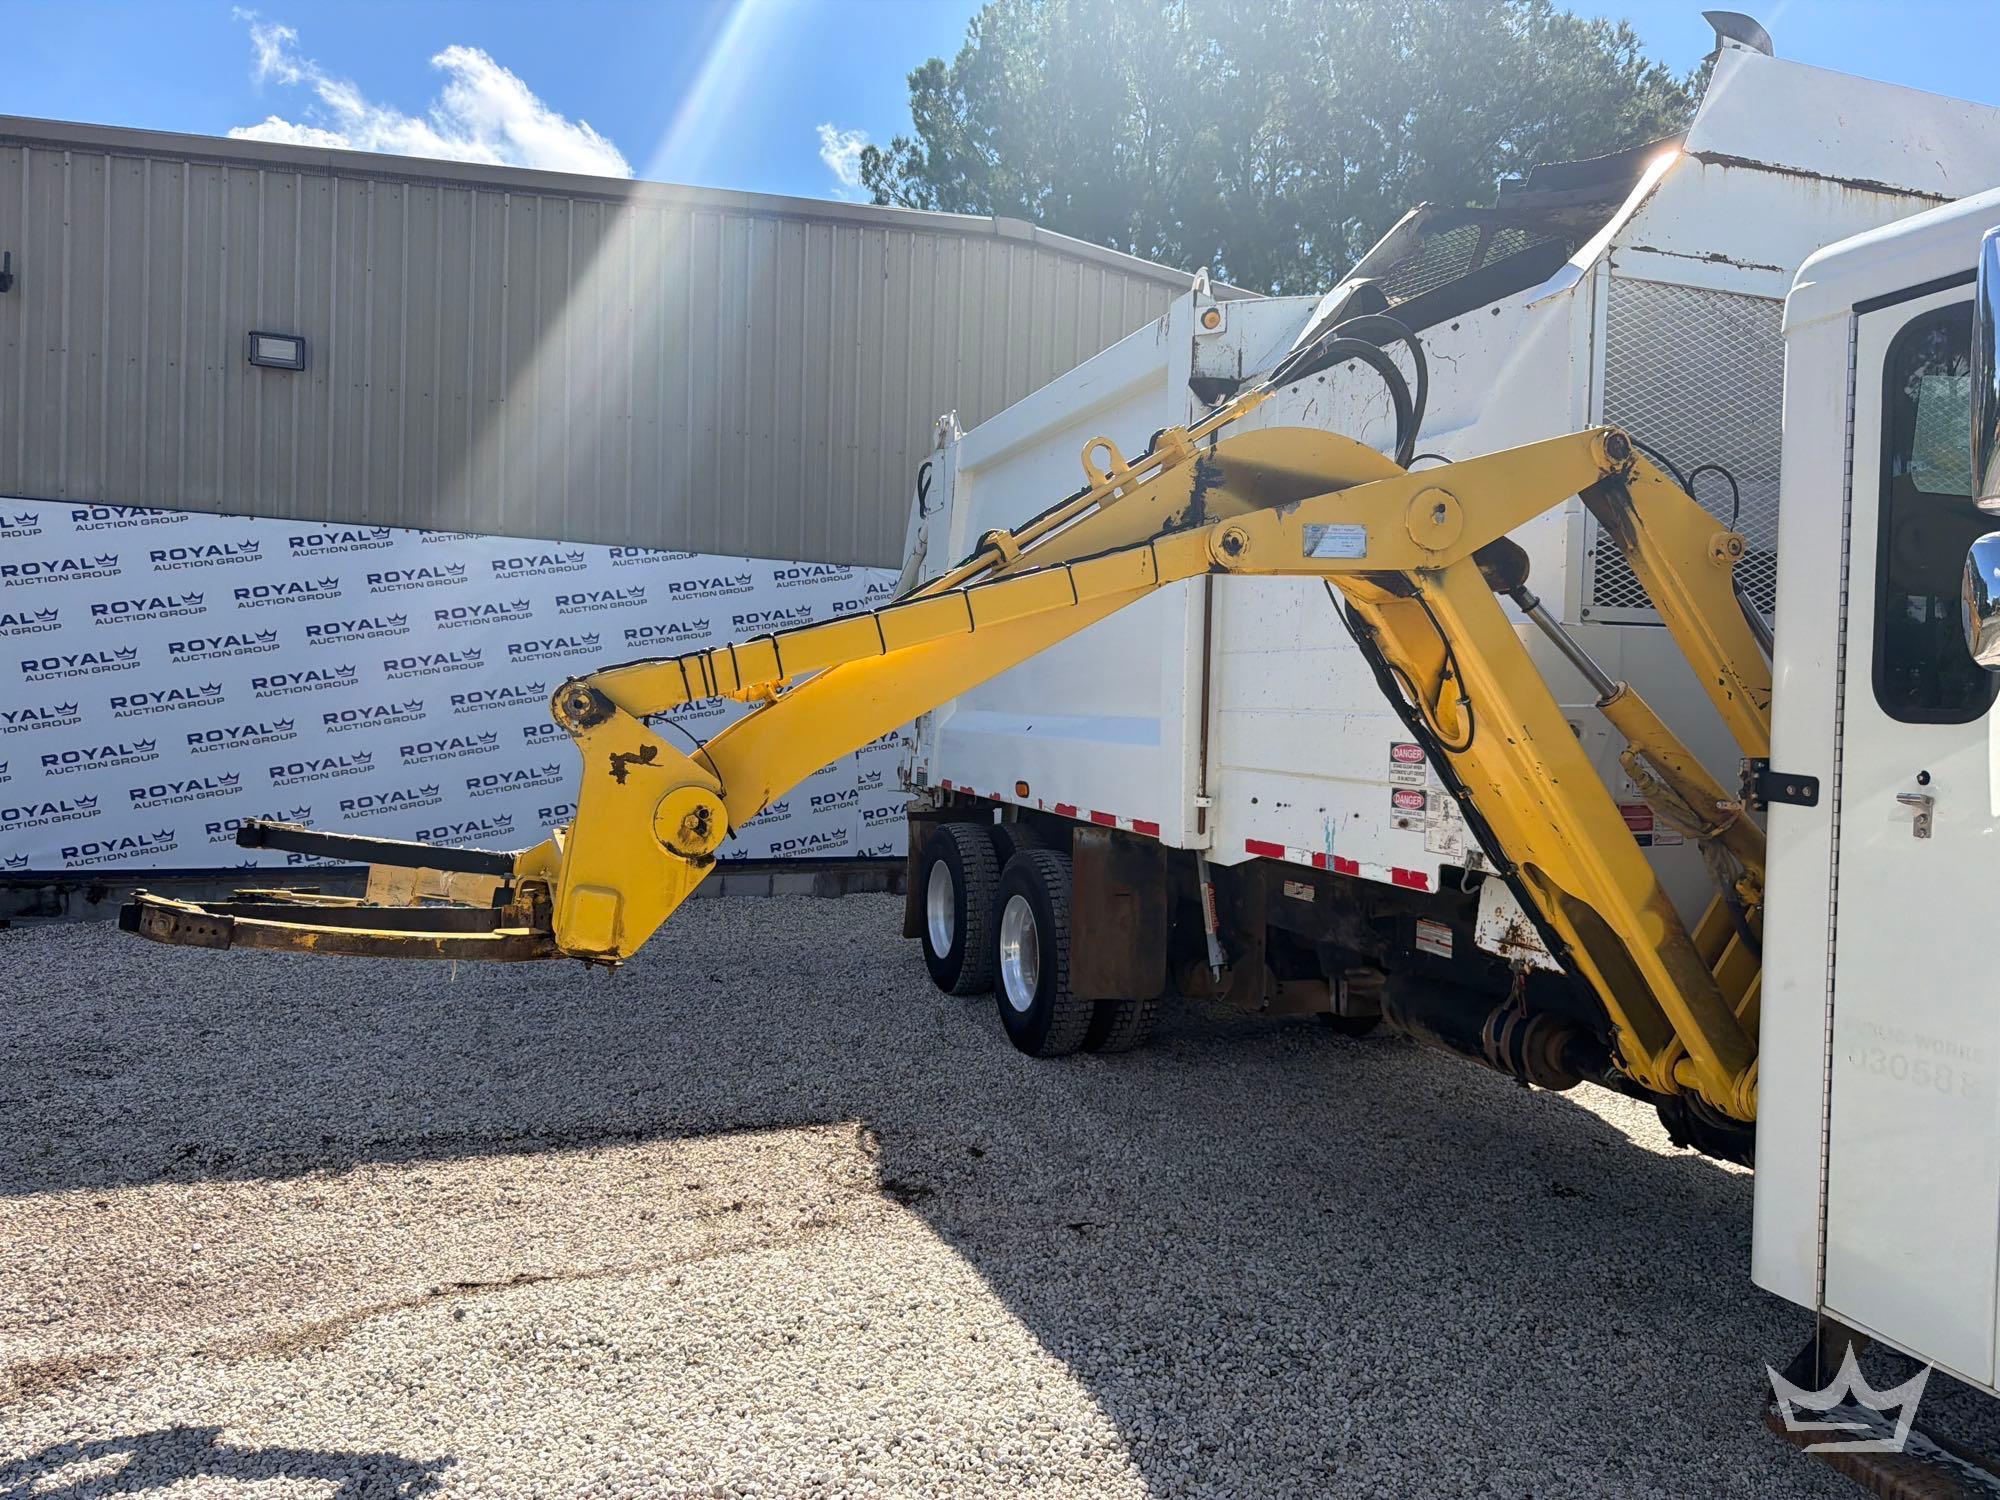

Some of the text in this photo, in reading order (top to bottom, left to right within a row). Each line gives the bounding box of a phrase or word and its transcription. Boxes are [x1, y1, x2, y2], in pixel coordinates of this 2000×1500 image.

[75, 515, 189, 531] AUCTION GROUP
[1, 528, 42, 538] ROUP
[288, 530, 371, 549] ROYAL
[149, 544, 238, 563] ROYAL
[292, 540, 394, 558] AUCTION GROUP
[0, 557, 96, 578] ROYAL
[153, 554, 263, 572] AUCTION GROUP
[491, 554, 566, 571] ROYAL
[612, 552, 698, 567] AUCTION GROUP
[4, 568, 122, 588] AUCTION GROUP
[366, 566, 446, 585] ROYAL
[495, 564, 588, 579] AUCTION GROUP
[773, 565, 836, 581] ROYAL
[776, 574, 853, 588] AUCTION GROUP
[234, 580, 319, 600] ROYAL
[370, 576, 468, 594] AUCTION GROUP
[668, 576, 736, 594] ROYAL
[672, 586, 754, 602] AUCTION GROUP
[90, 596, 182, 617] ROYAL
[237, 590, 342, 609] AUCTION GROUP
[555, 589, 628, 607] ROYAL
[558, 598, 648, 615] AUCTION GROUP
[94, 606, 207, 626] AUCTION GROUP
[434, 602, 512, 621] ROYAL
[438, 612, 533, 630] AUCTION GROUP
[732, 608, 796, 626] ROYAL
[11, 623, 62, 635] GROUP
[306, 617, 388, 637] ROYAL
[624, 622, 694, 640] ROYAL
[734, 617, 814, 634] AUCTION GROUP
[168, 634, 256, 655] ROYAL
[309, 627, 410, 646] AUCTION GROUP
[507, 636, 582, 656] ROYAL
[626, 630, 712, 648] AUCTION GROUP
[20, 651, 115, 674] ROYAL
[172, 644, 280, 664] AUCTION GROUP
[383, 652, 462, 672] ROYAL
[511, 645, 602, 663] AUCTION GROUP
[24, 661, 141, 682] AUCTION GROUP
[251, 669, 336, 690] ROYAL
[387, 661, 484, 680] AUCTION GROUP
[255, 678, 359, 699] AUCTION GROUP
[450, 686, 527, 706] ROYAL
[110, 687, 200, 710] ROYAL
[114, 696, 225, 718] AUCTION GROUP
[453, 694, 548, 714] AUCTION GROUP
[1, 707, 55, 723] YAL
[31, 717, 82, 730] GROUP
[322, 704, 404, 725] ROYAL
[326, 712, 426, 734] AUCTION GROUP
[690, 708, 726, 720] GROUP
[186, 723, 274, 746] ROYAL
[190, 732, 298, 754] AUCTION GROUP
[40, 744, 134, 768] ROYAL
[400, 736, 478, 758] ROYAL
[403, 744, 500, 766] AUCTION GROUP
[1394, 748, 1422, 759] DANGER
[45, 753, 160, 776] AUCTION GROUP
[269, 756, 352, 779] ROYAL
[272, 764, 375, 788] AUCTION GROUP
[466, 768, 542, 790] ROYAL
[129, 778, 219, 802] ROYAL
[469, 776, 564, 798] AUCTION GROUP
[133, 786, 243, 810] AUCTION GROUP
[339, 789, 420, 812] ROYAL
[810, 789, 859, 806] ROYA
[1394, 794, 1422, 805] DANGER
[1, 800, 74, 821] OYAL
[51, 809, 102, 823] GROUP
[343, 797, 442, 820] AUCTION GROUP
[812, 801, 854, 814] AUCTION
[757, 813, 792, 825] GROUP
[865, 815, 906, 827] AUCTION
[416, 819, 493, 842] ROYAL
[474, 827, 515, 840] GROUP
[60, 834, 153, 860] ROYAL
[770, 832, 832, 854] ROYAL
[815, 839, 849, 852] GROUP
[66, 843, 178, 868] AUCTION GROUP
